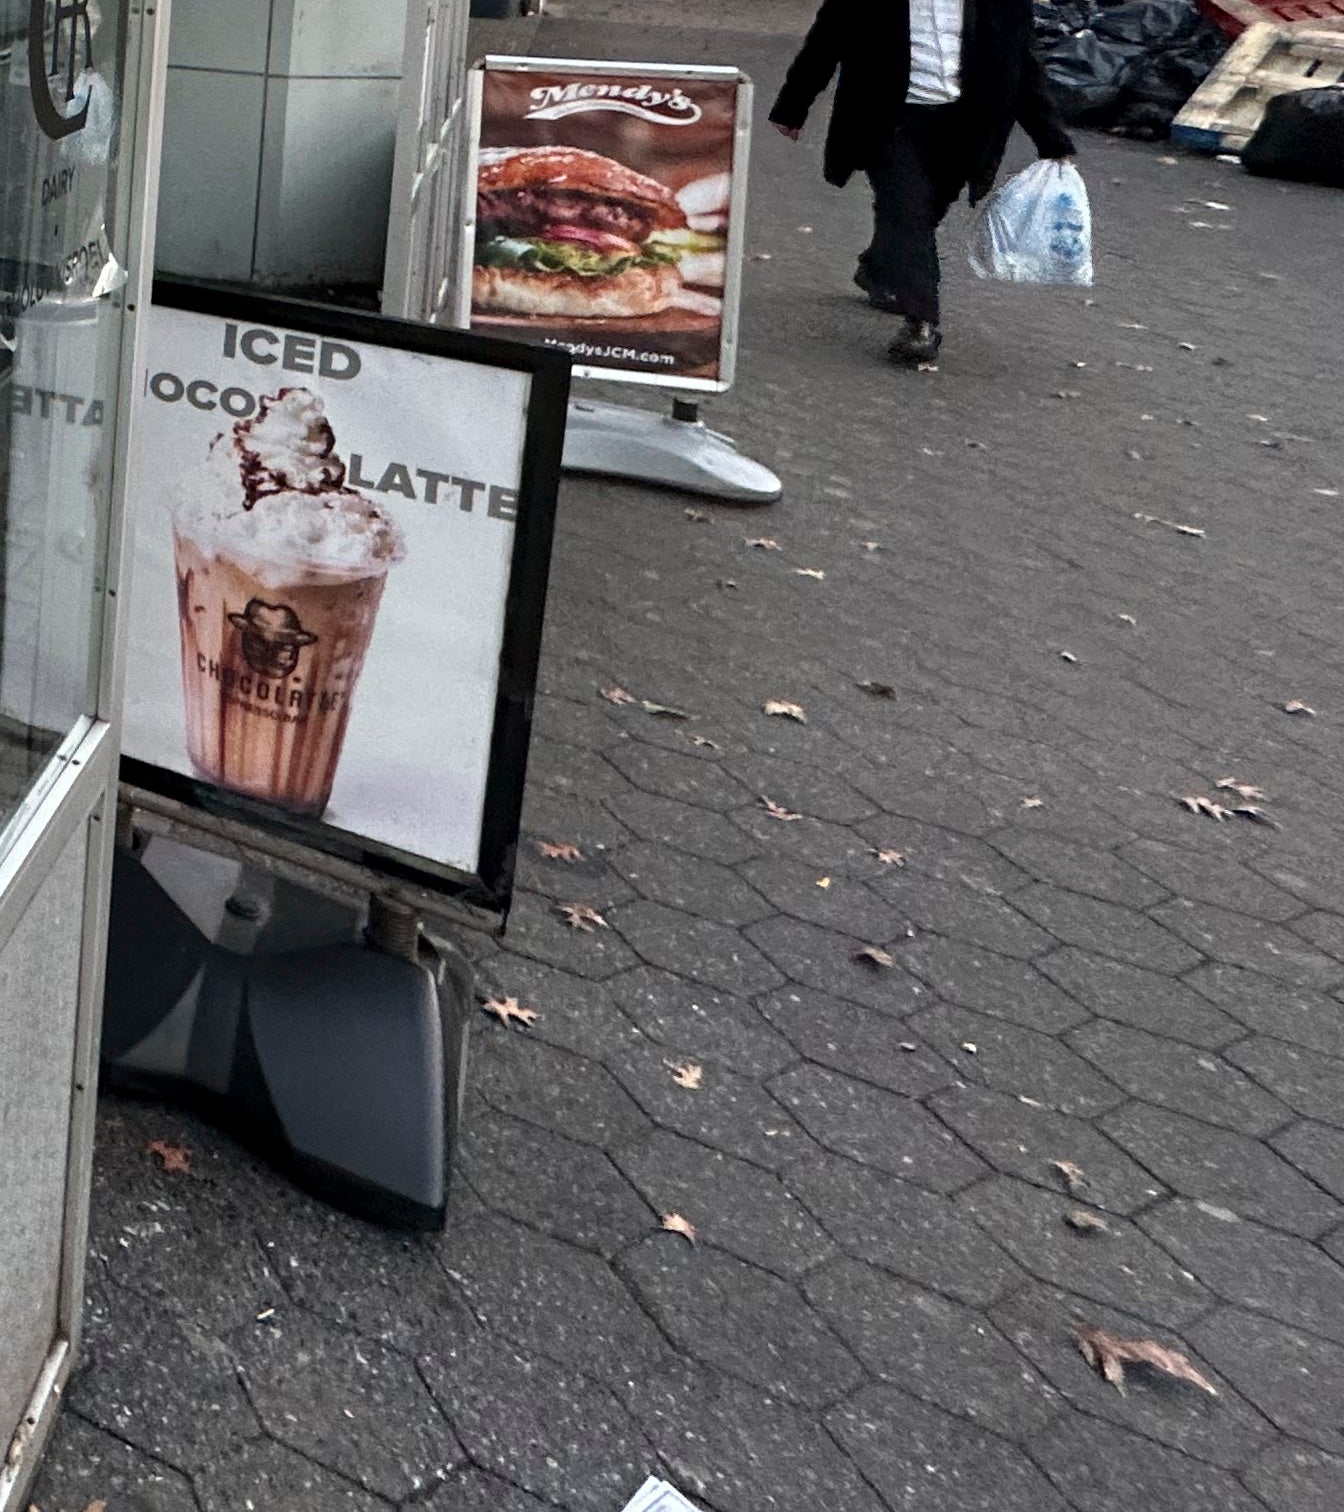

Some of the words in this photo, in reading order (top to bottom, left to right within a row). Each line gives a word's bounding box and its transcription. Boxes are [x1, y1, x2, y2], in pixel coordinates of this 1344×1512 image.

[530, 82, 692, 111] Mendy's
[223, 323, 363, 381] ICED
[348, 453, 519, 522] LATTE
